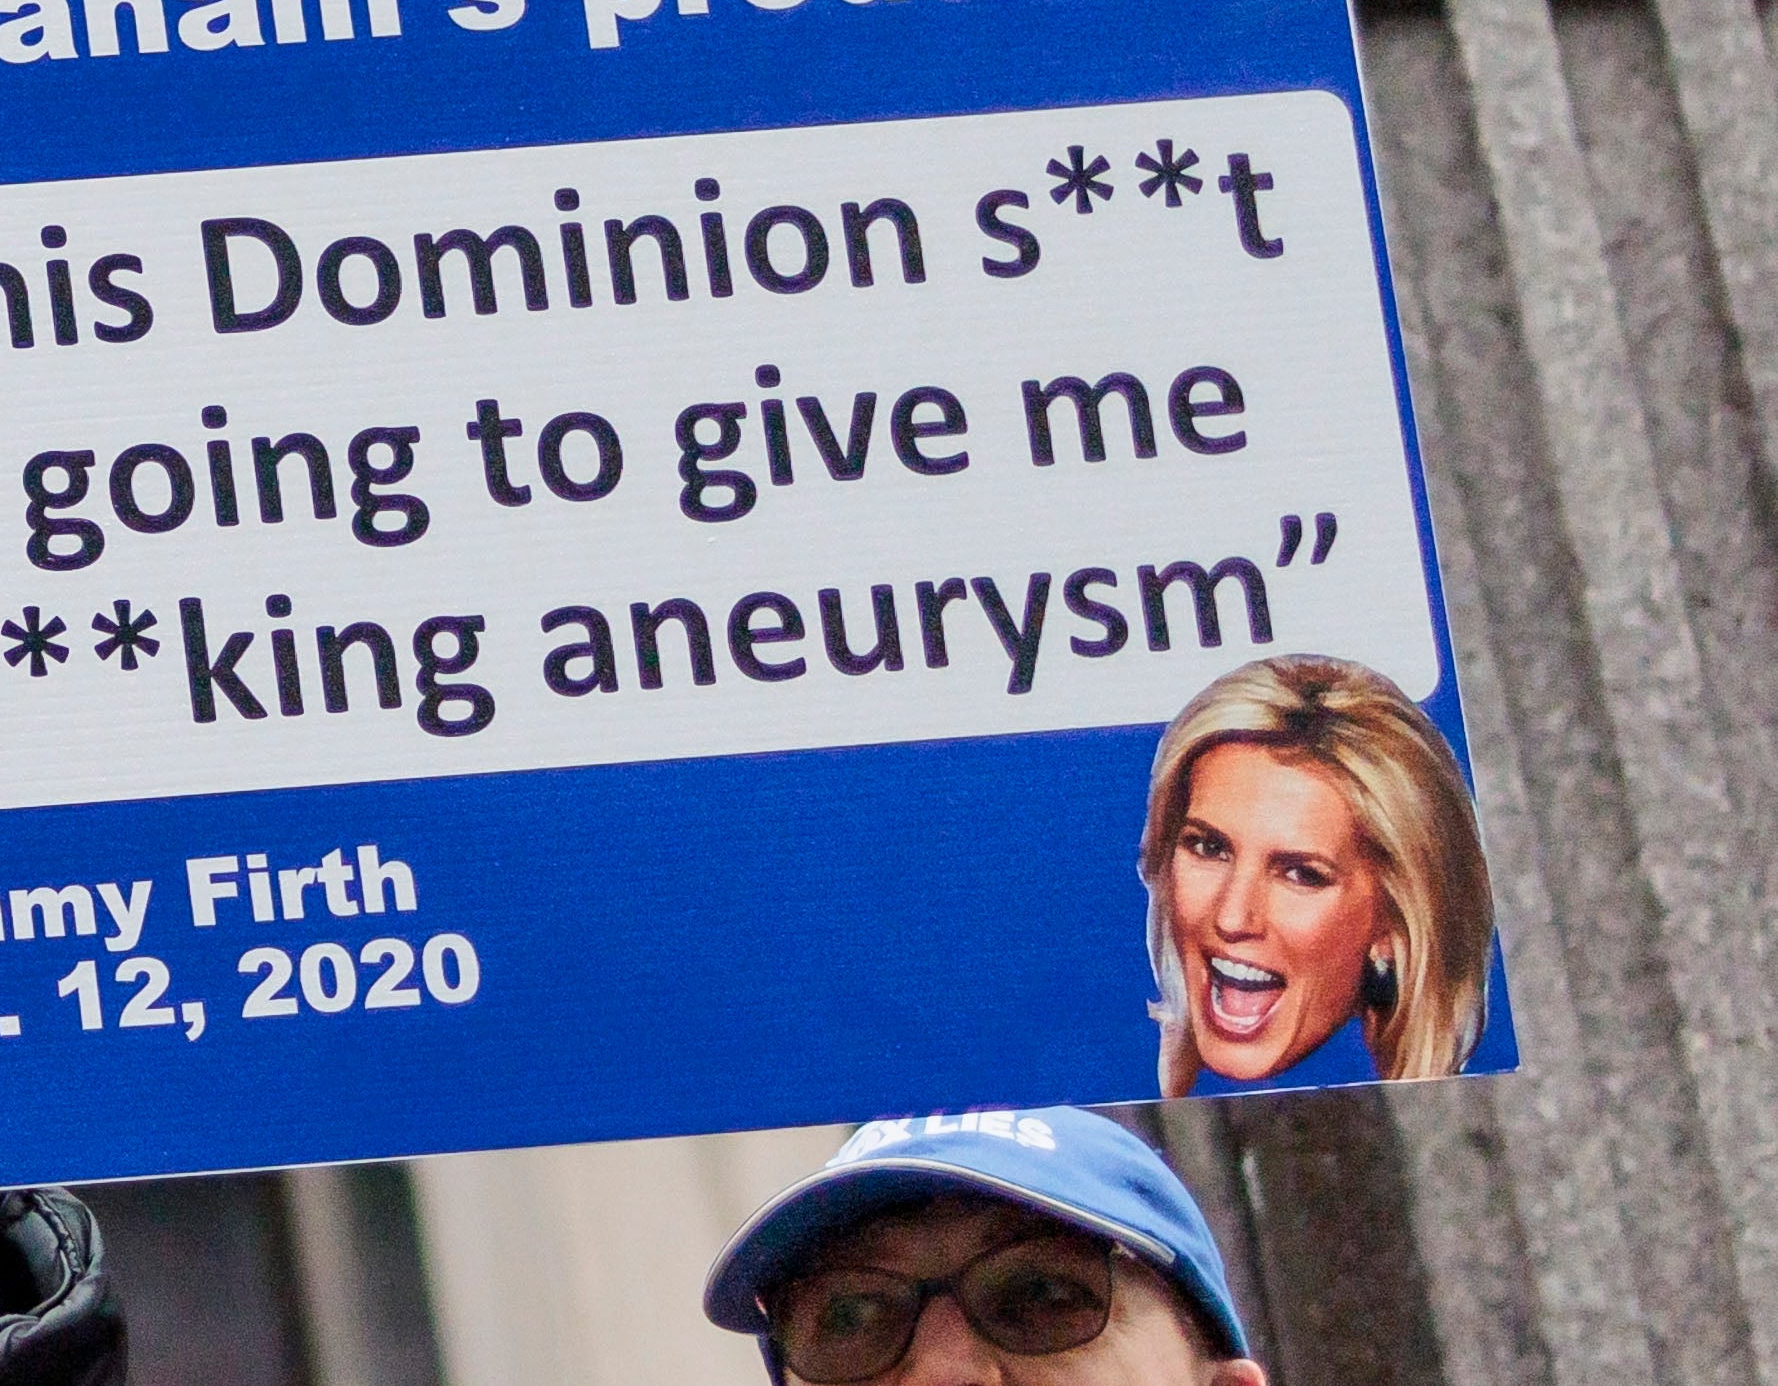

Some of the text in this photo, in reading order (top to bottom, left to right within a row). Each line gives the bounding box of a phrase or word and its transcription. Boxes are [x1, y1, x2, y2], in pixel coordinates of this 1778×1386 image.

[203, 176, 926, 336] Dominion
[22, 405, 430, 572] going
[466, 398, 624, 507] to
[675, 364, 970, 523] give
[1021, 366, 1247, 467] me
[541, 512, 1338, 697] aneurysm”
[186, 845, 417, 927] Firth
[57, 956, 206, 1042] 12,
[237, 932, 481, 1019] 2020
[924, 1111, 1056, 1151] LIES
